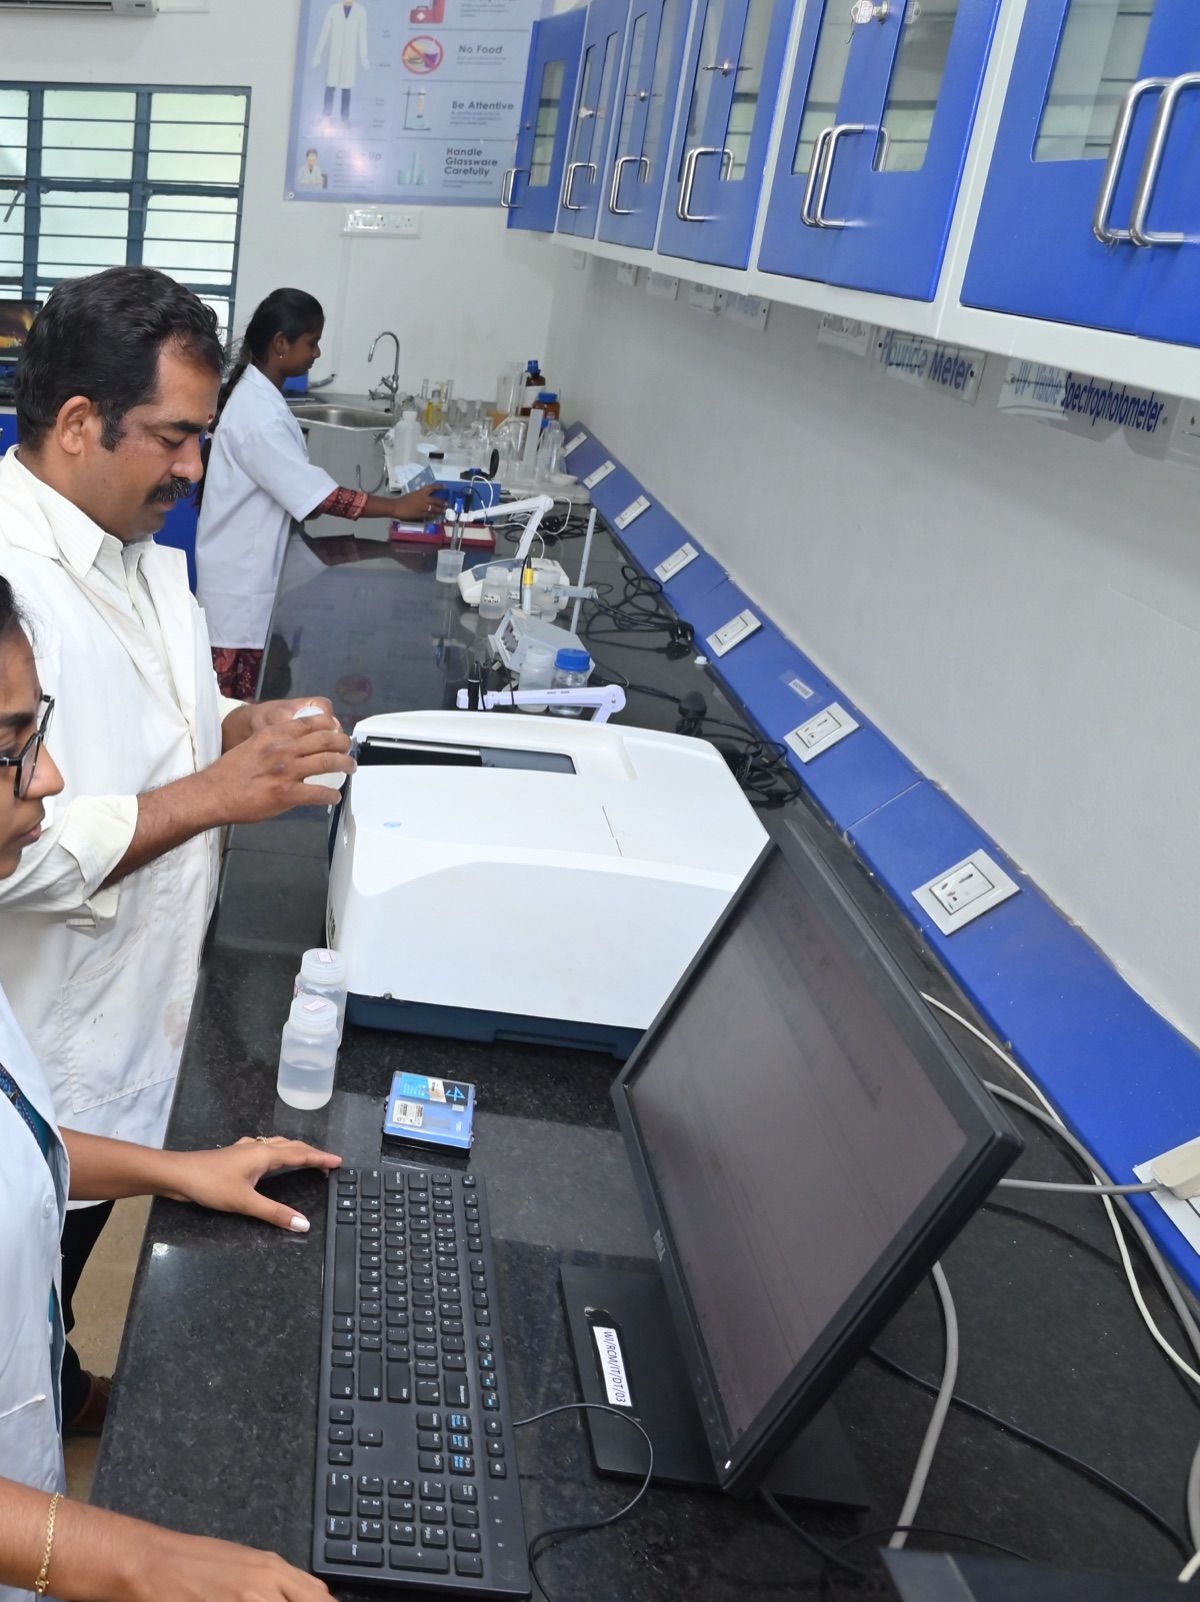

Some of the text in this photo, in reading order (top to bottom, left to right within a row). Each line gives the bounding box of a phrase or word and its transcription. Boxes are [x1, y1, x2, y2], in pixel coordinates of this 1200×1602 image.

[458, 44, 503, 54] No Food
[452, 100, 515, 111] Be Attentive
[446, 147, 483, 157] Handle
[445, 157, 498, 167] Glassware
[444, 166, 490, 177] Carefully
[928, 346, 973, 391] Meter
[1060, 372, 1164, 433] Spectrophotometer
[603, 1331, 626, 1403] WI/RCM/IT/DT/03
